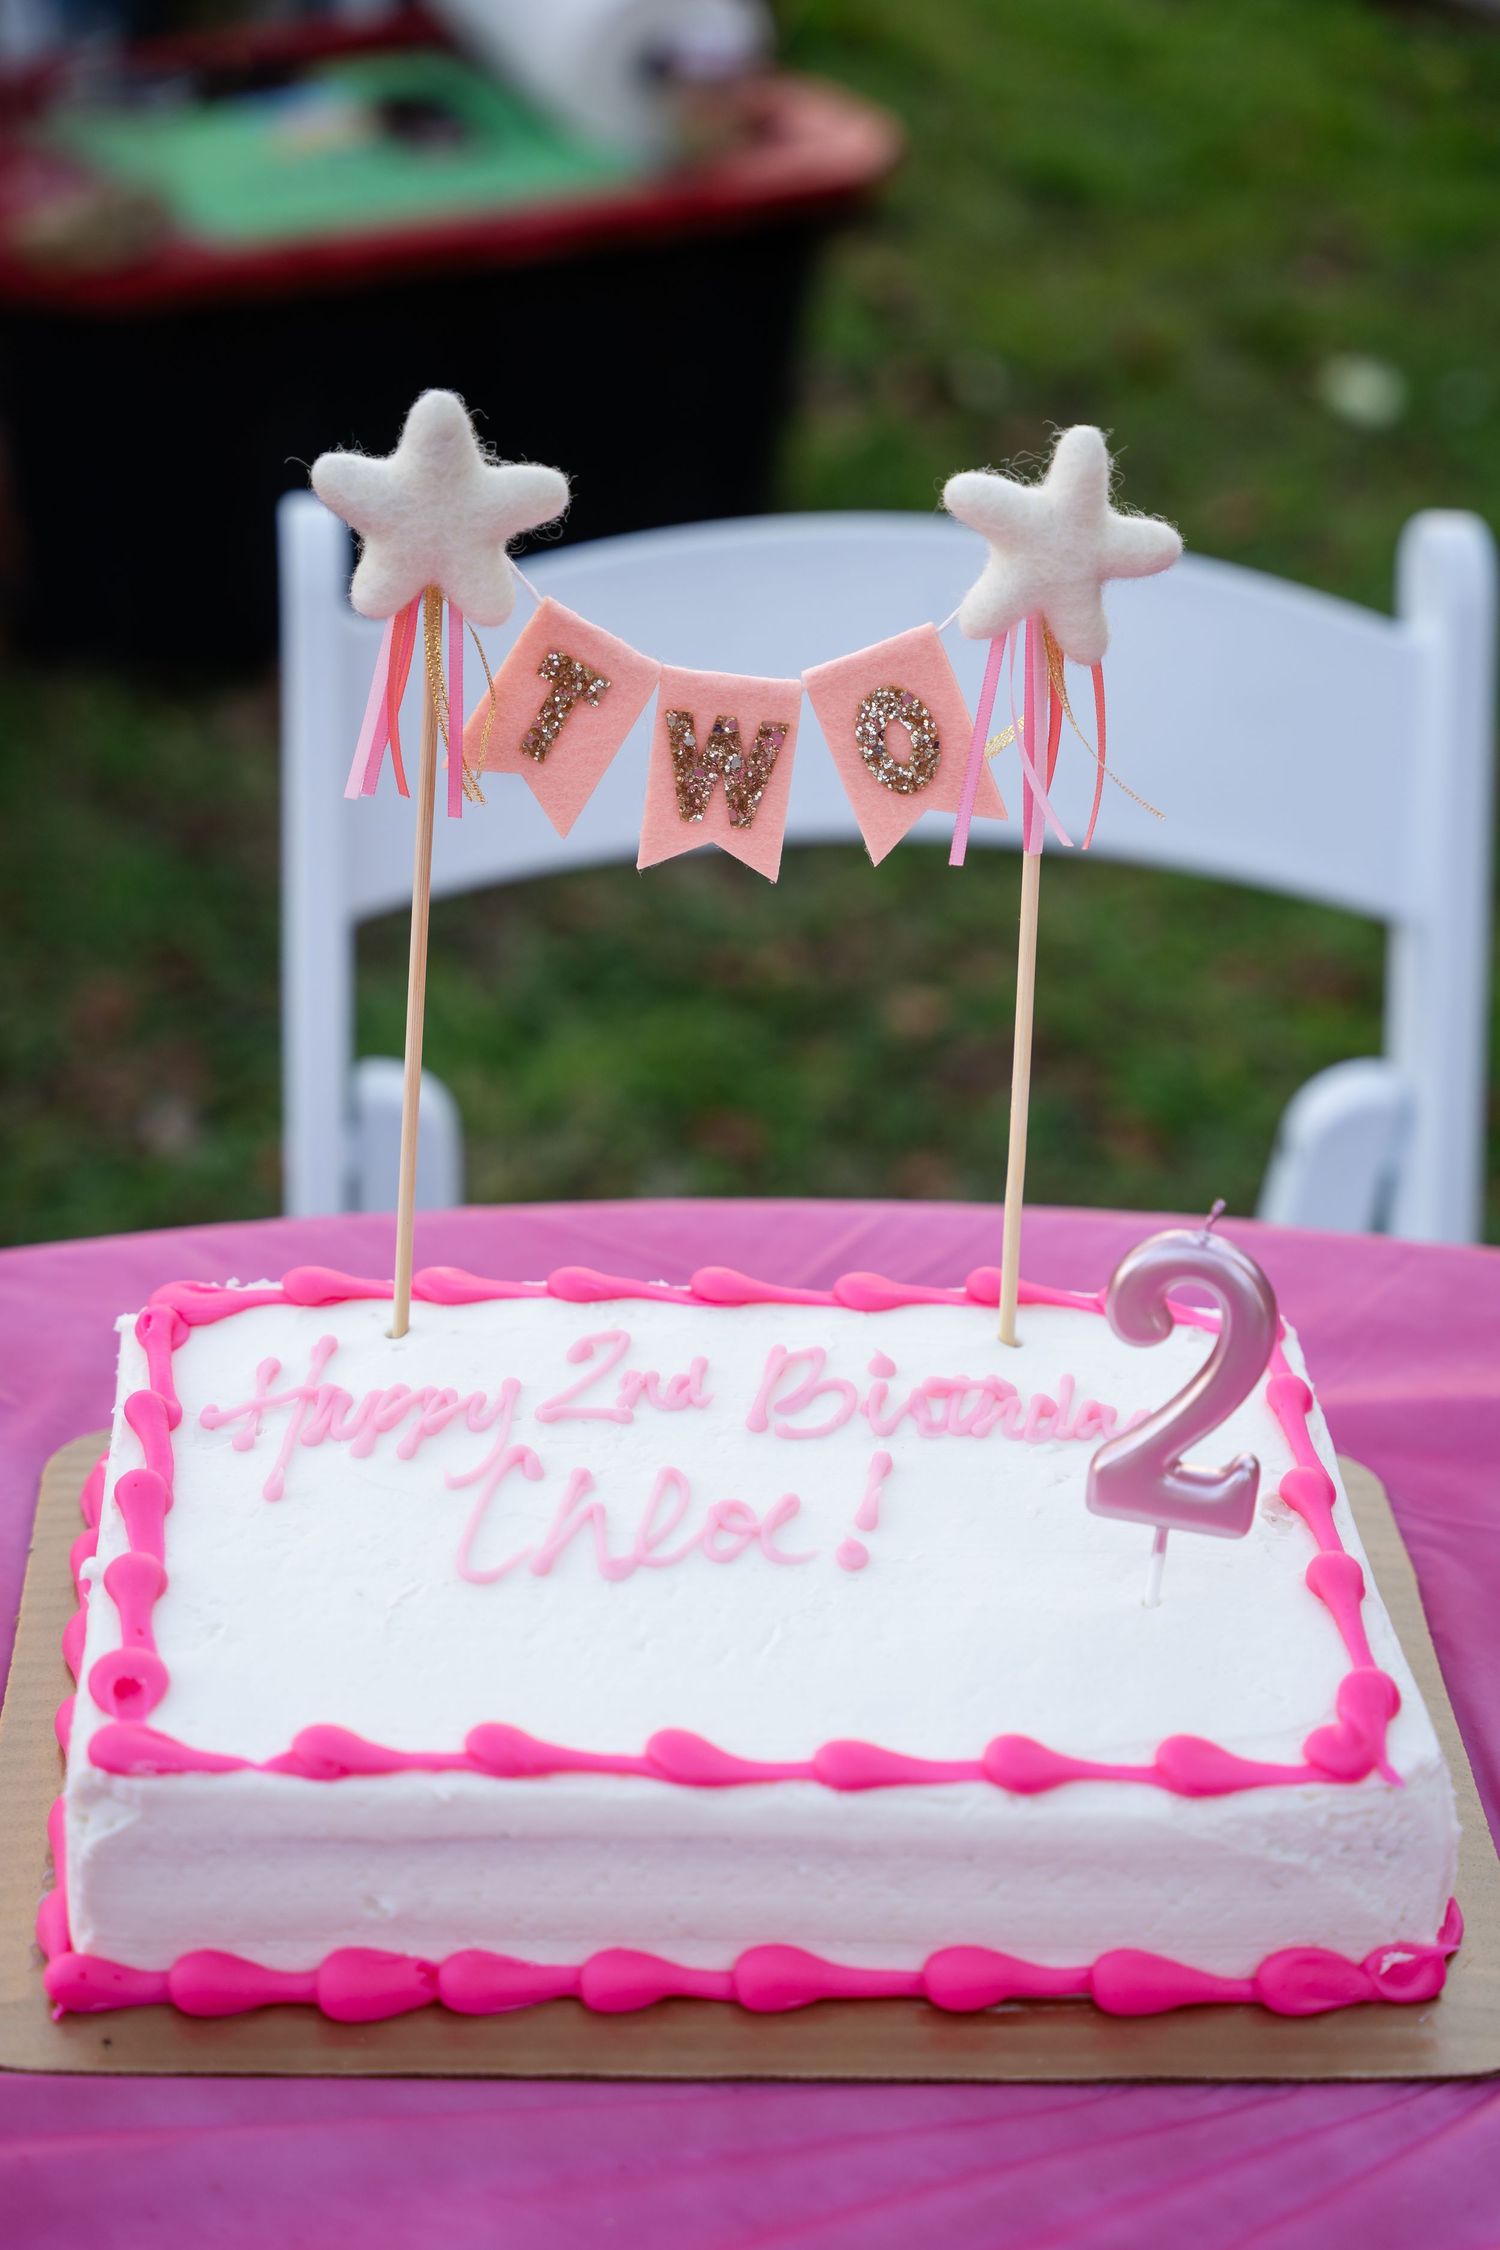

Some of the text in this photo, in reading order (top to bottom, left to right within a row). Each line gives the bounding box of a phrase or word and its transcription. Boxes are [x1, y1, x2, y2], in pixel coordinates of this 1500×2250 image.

[520, 648, 942, 830] TWO
[199, 1335, 522, 1502] Happy
[535, 1330, 716, 1425] 2nd
[1086, 1228, 1279, 1540] 2
